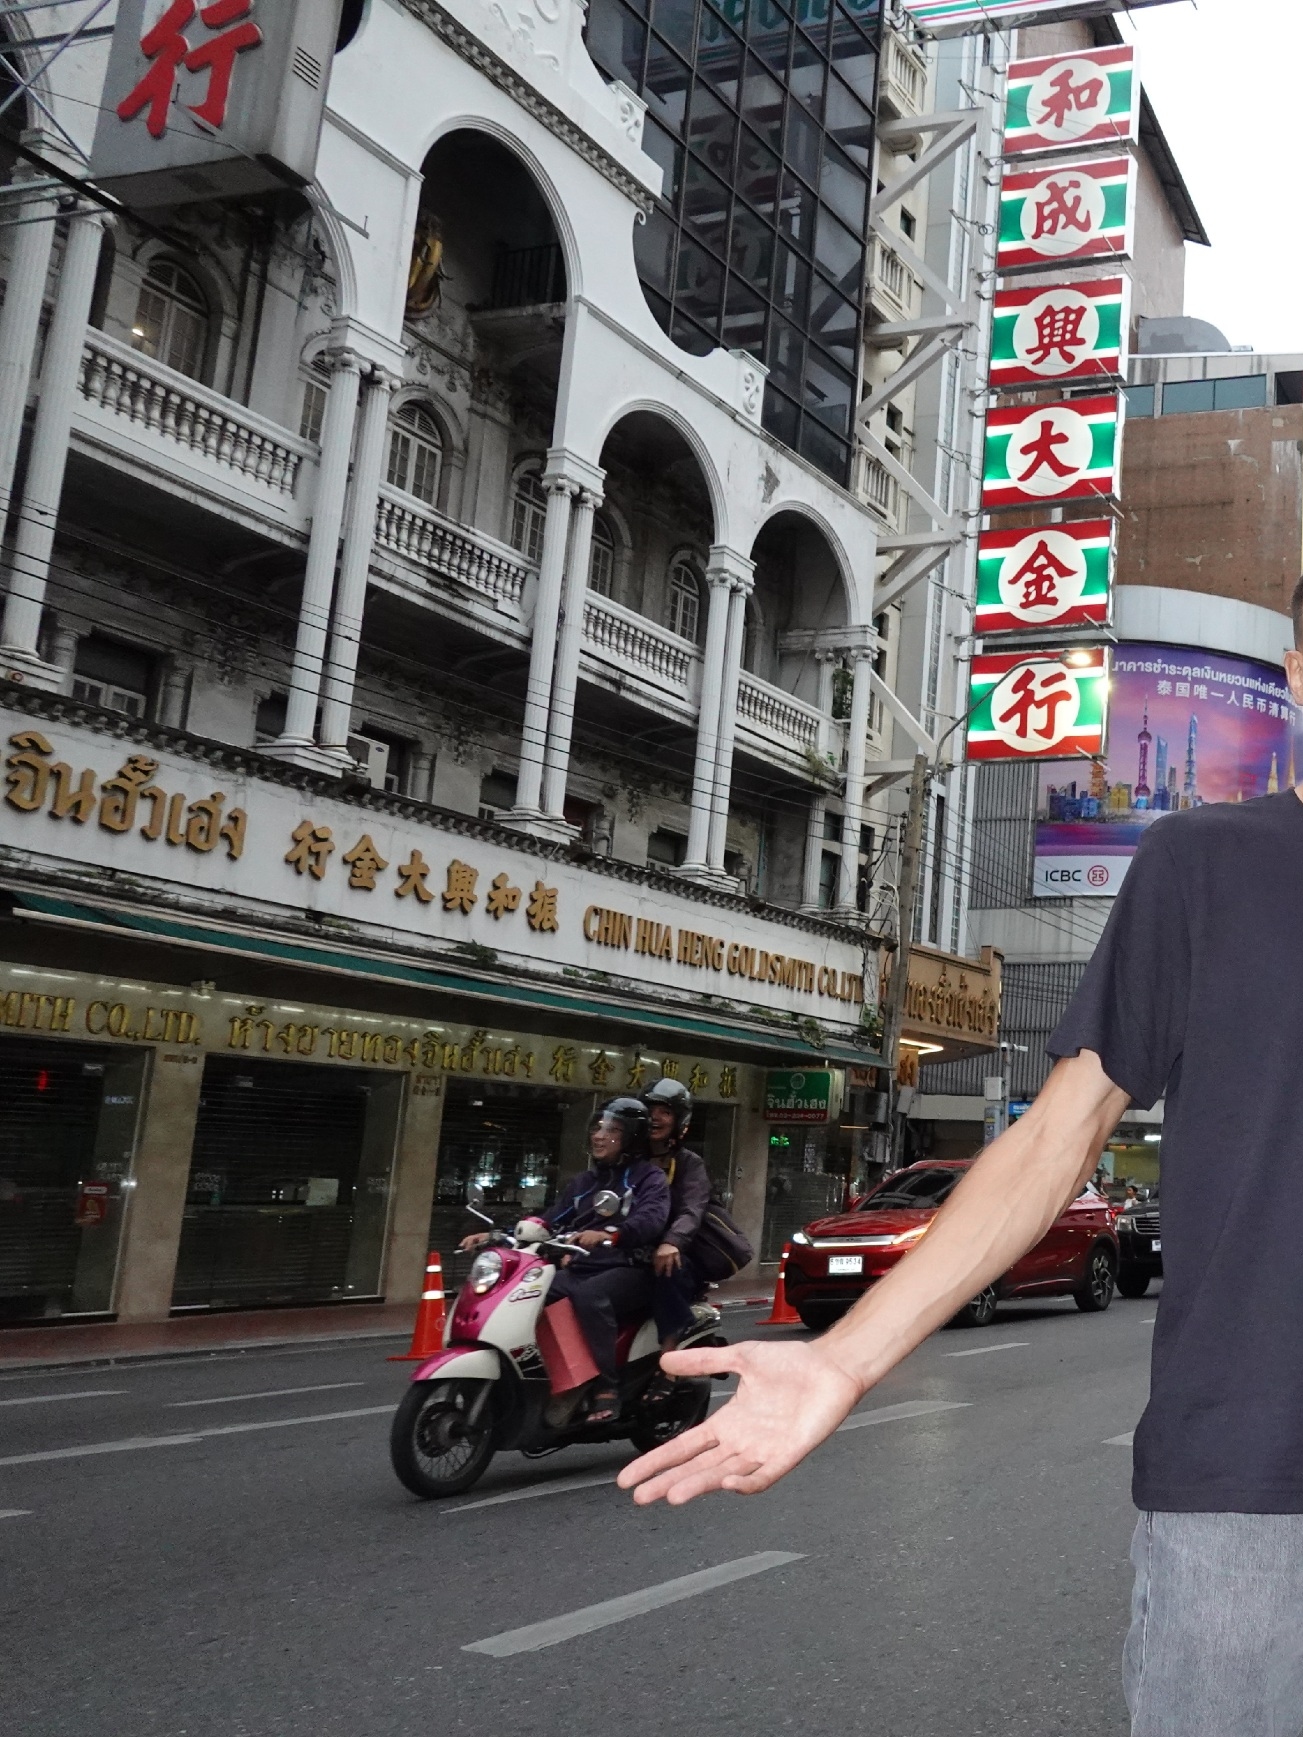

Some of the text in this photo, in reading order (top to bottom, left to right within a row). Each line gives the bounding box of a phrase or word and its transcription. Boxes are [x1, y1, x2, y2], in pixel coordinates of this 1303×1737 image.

[117, 0, 263, 139] 行
[1045, 869, 1082, 883] ICBC
[583, 905, 633, 951] CHIN
[634, 917, 673, 960] HUA
[677, 929, 725, 972] HENG
[727, 942, 816, 993] GOLDSMITH
